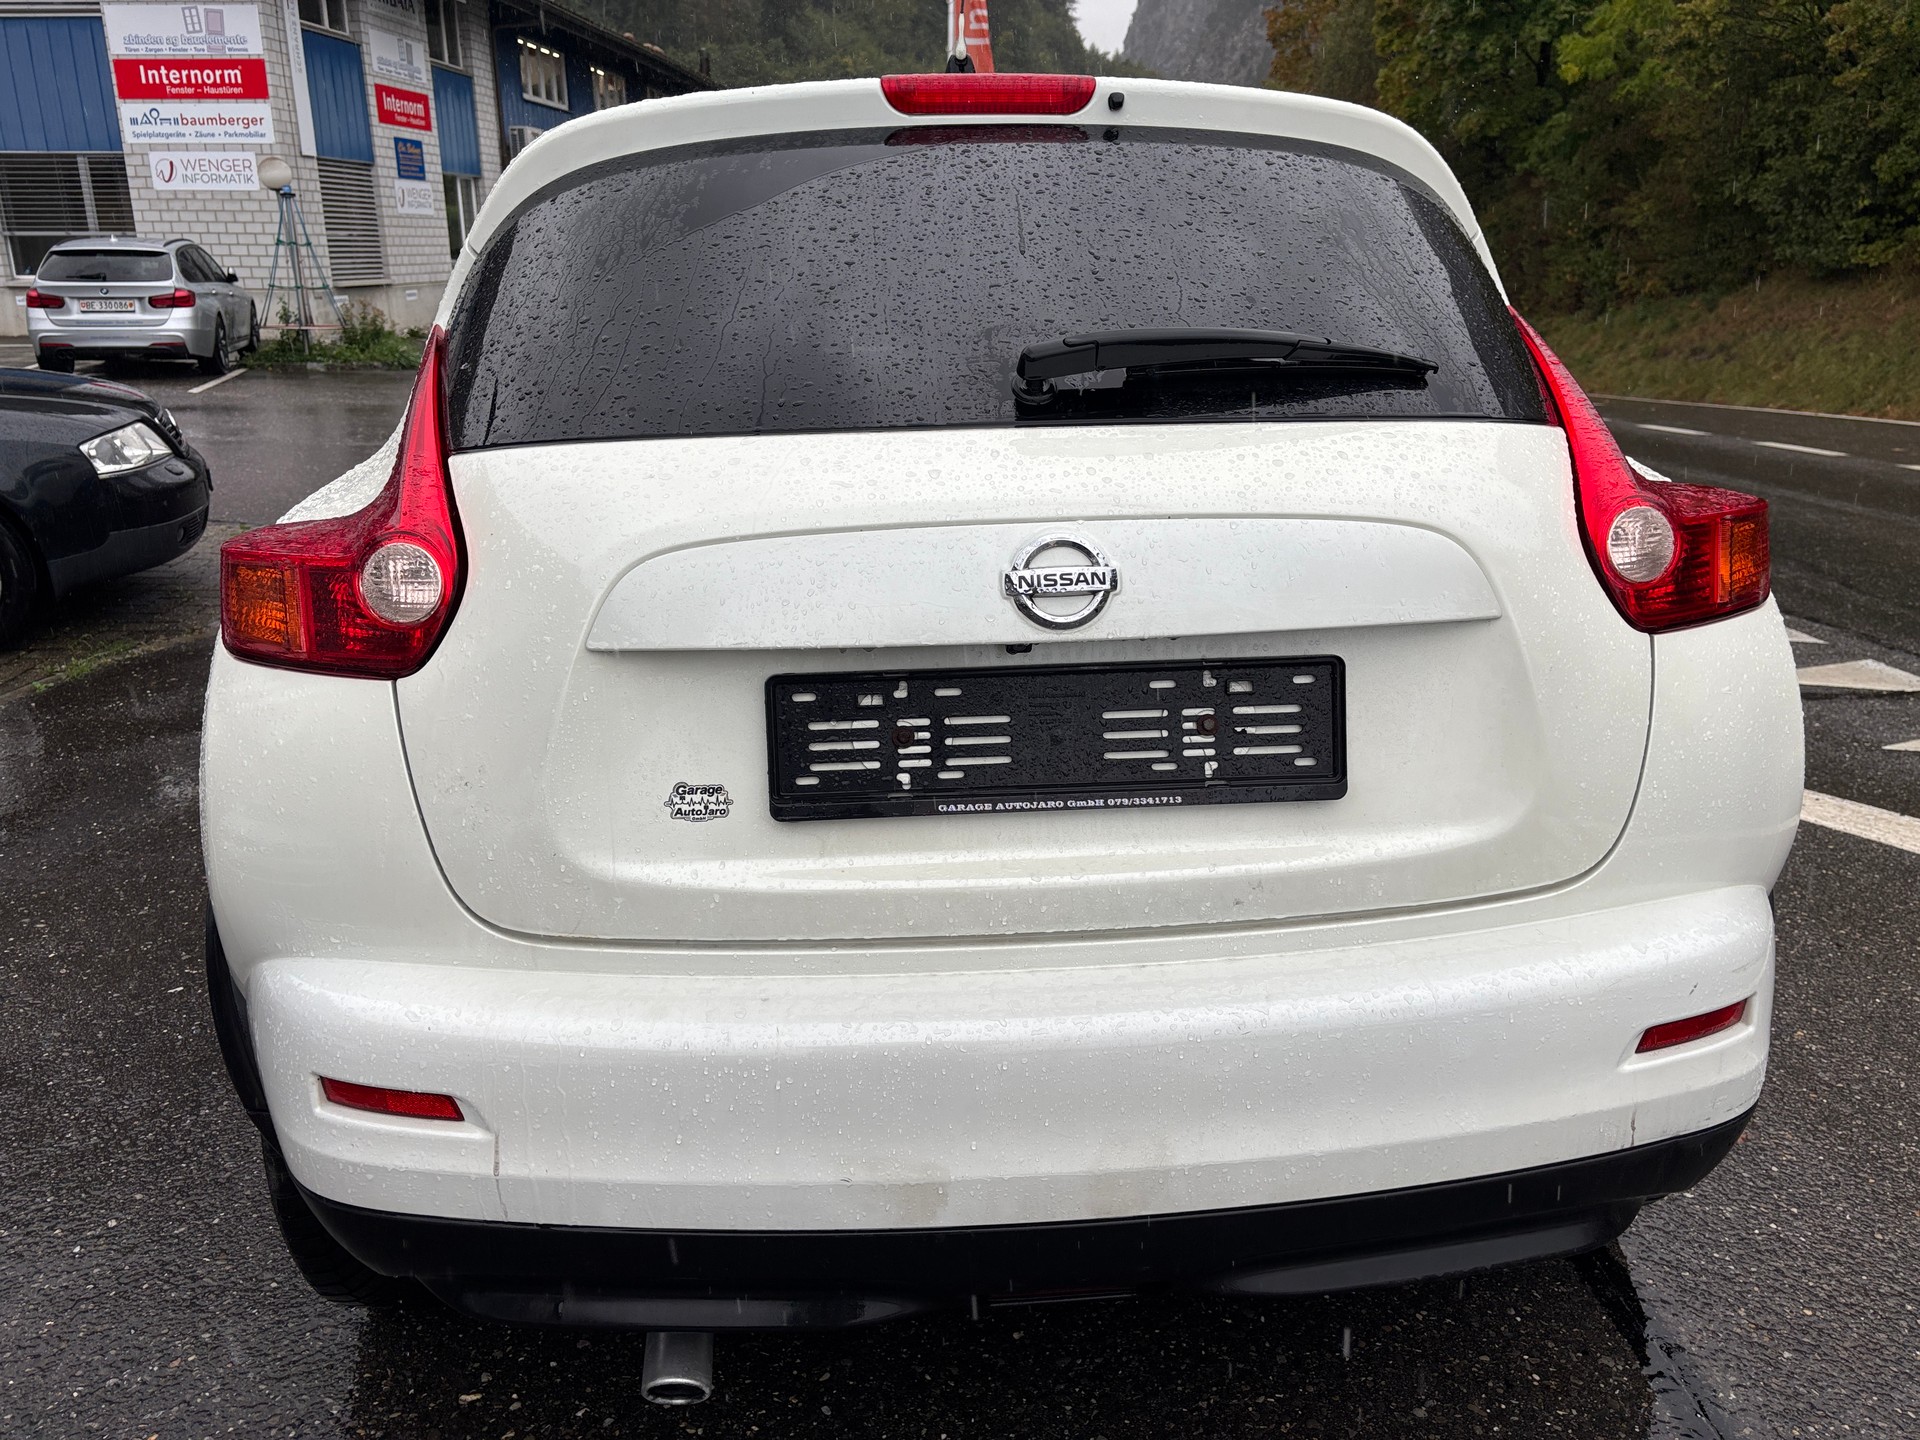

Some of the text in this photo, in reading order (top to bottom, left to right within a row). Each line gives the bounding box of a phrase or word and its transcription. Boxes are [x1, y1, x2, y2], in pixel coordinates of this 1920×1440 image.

[123, 34, 248, 47] zbinden ag bauelemente
[139, 65, 242, 84] Internorm
[166, 85, 243, 95] Fenster Haustüren
[382, 91, 425, 117] Internorm
[180, 113, 265, 129] baumberger
[132, 131, 186, 139] Spielplatzgeräte
[180, 158, 253, 173] WENGER
[182, 173, 255, 184] INFORMATIK
[86, 300, 96, 310] BE
[1018, 572, 1106, 589] NISSAN
[675, 785, 723, 797] Garage
[938, 796, 1182, 812] GARAGE AUTOJARO GmbH 079/3341713
[674, 805, 727, 817] AutoJaro
